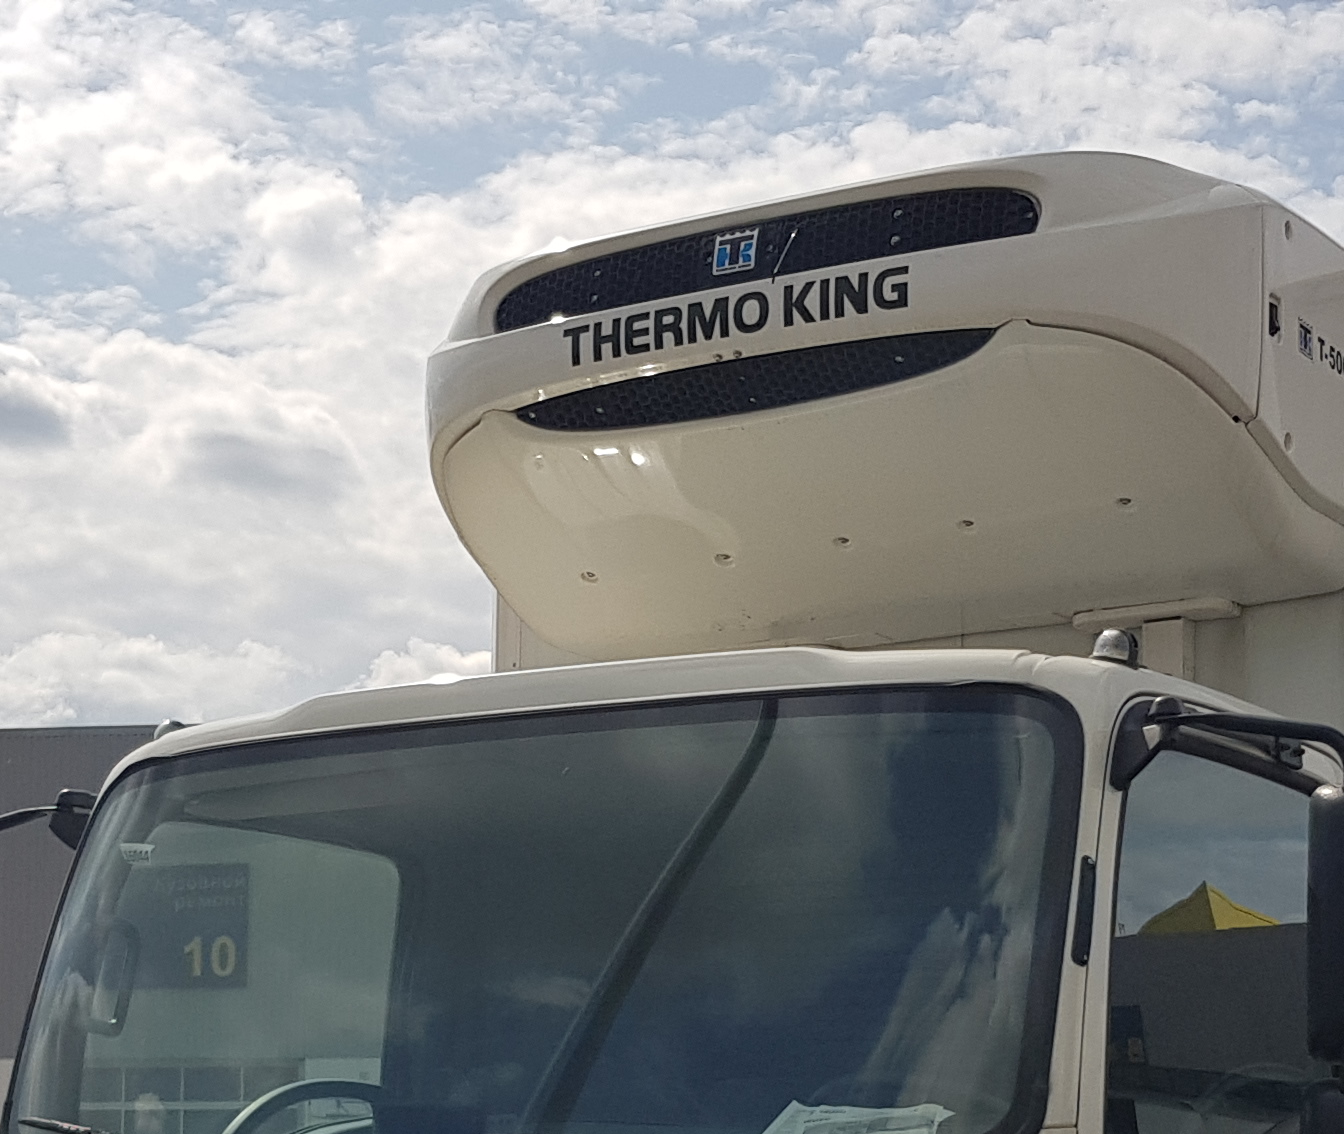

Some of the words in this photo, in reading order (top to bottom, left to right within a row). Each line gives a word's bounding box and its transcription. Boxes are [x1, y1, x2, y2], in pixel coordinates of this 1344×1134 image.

[563, 292, 769, 367] THERMO
[783, 266, 909, 327] KING
[183, 935, 236, 977] 10
